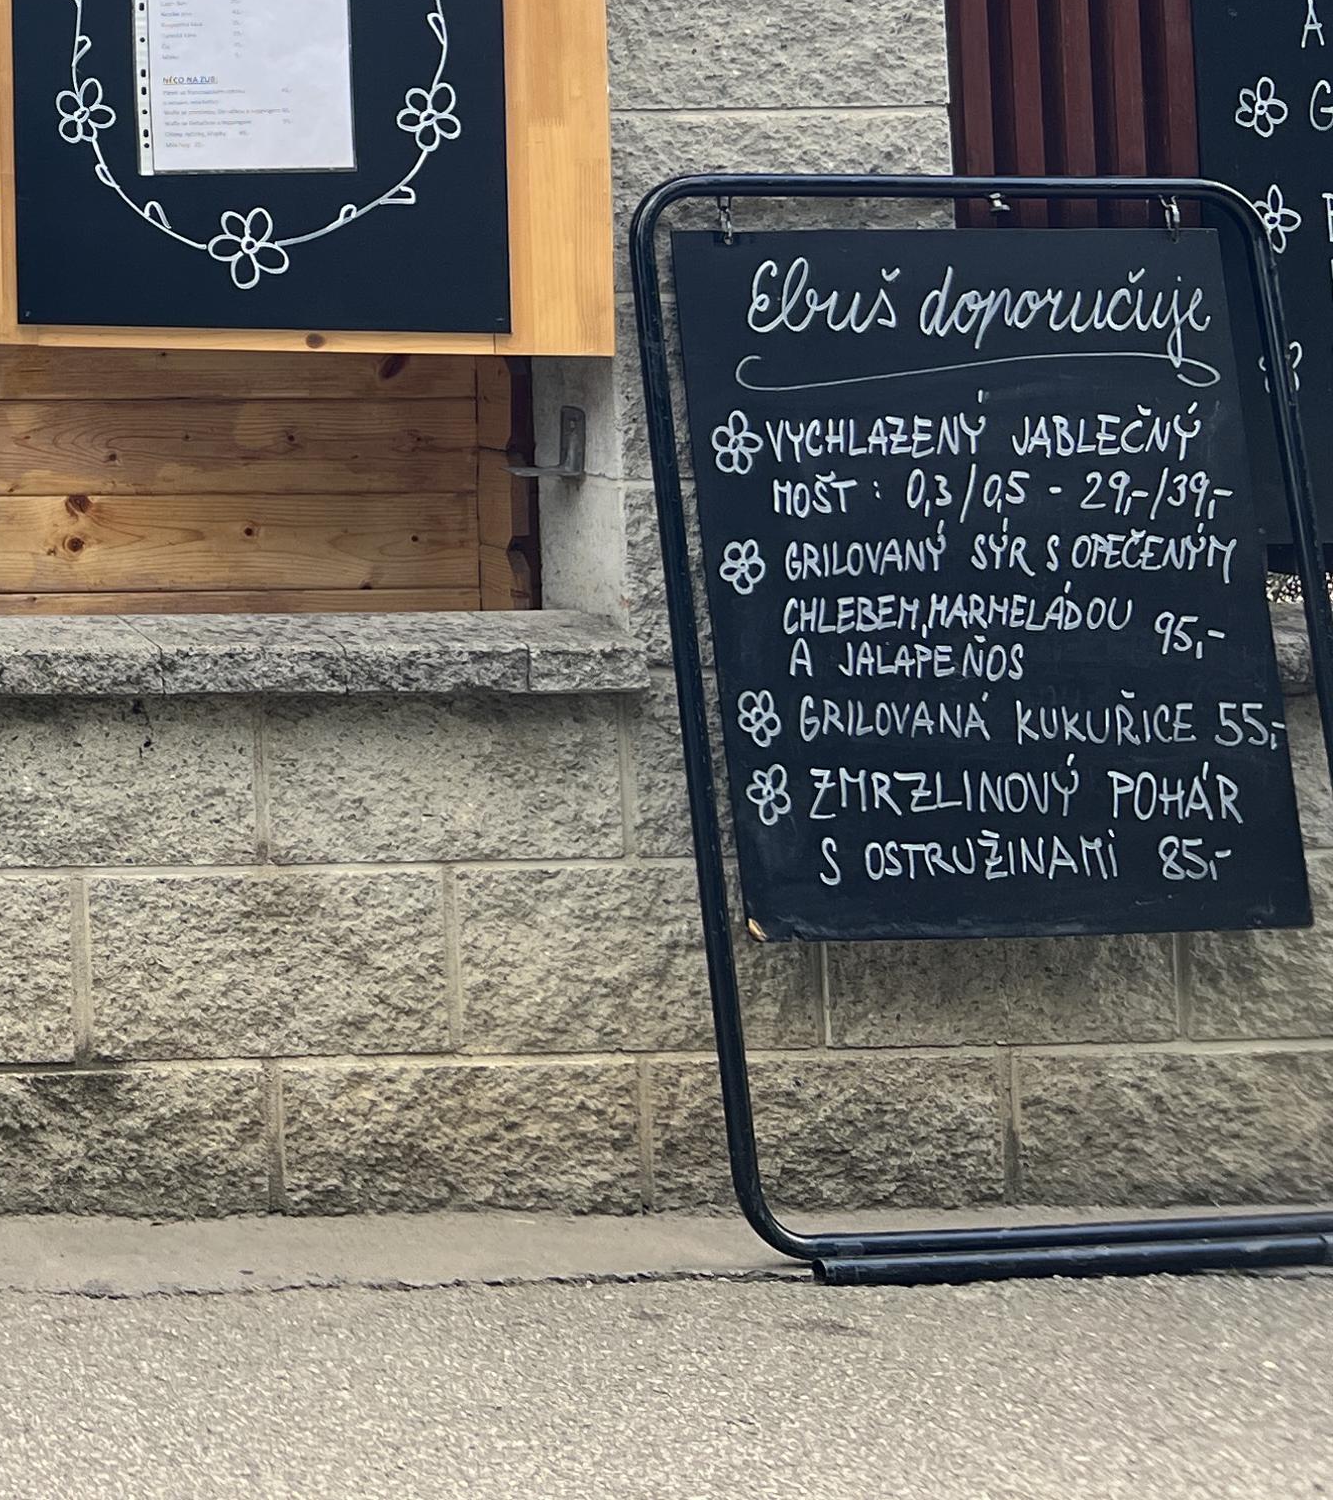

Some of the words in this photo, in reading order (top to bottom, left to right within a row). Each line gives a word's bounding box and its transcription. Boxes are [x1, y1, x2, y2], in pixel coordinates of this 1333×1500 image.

[747, 257, 901, 333] Ebuš
[918, 266, 1212, 368] doporučuje
[764, 389, 988, 462] VYCHLAZENÝ
[1012, 402, 1202, 461] JABLEČNÝ
[784, 519, 947, 580] GRILOVANÝ
[971, 517, 1036, 577] SÝR
[1046, 536, 1061, 571] S
[1071, 523, 1237, 585] OPEČENÝM
[789, 638, 813, 678] A
[799, 692, 992, 743] GRILOVANÁ
[1016, 689, 1196, 746] KUKUŘICE
[810, 754, 1081, 820] ZMRZLINOVÝ
[1107, 762, 1244, 825] POHÁR
[819, 838, 842, 886] S
